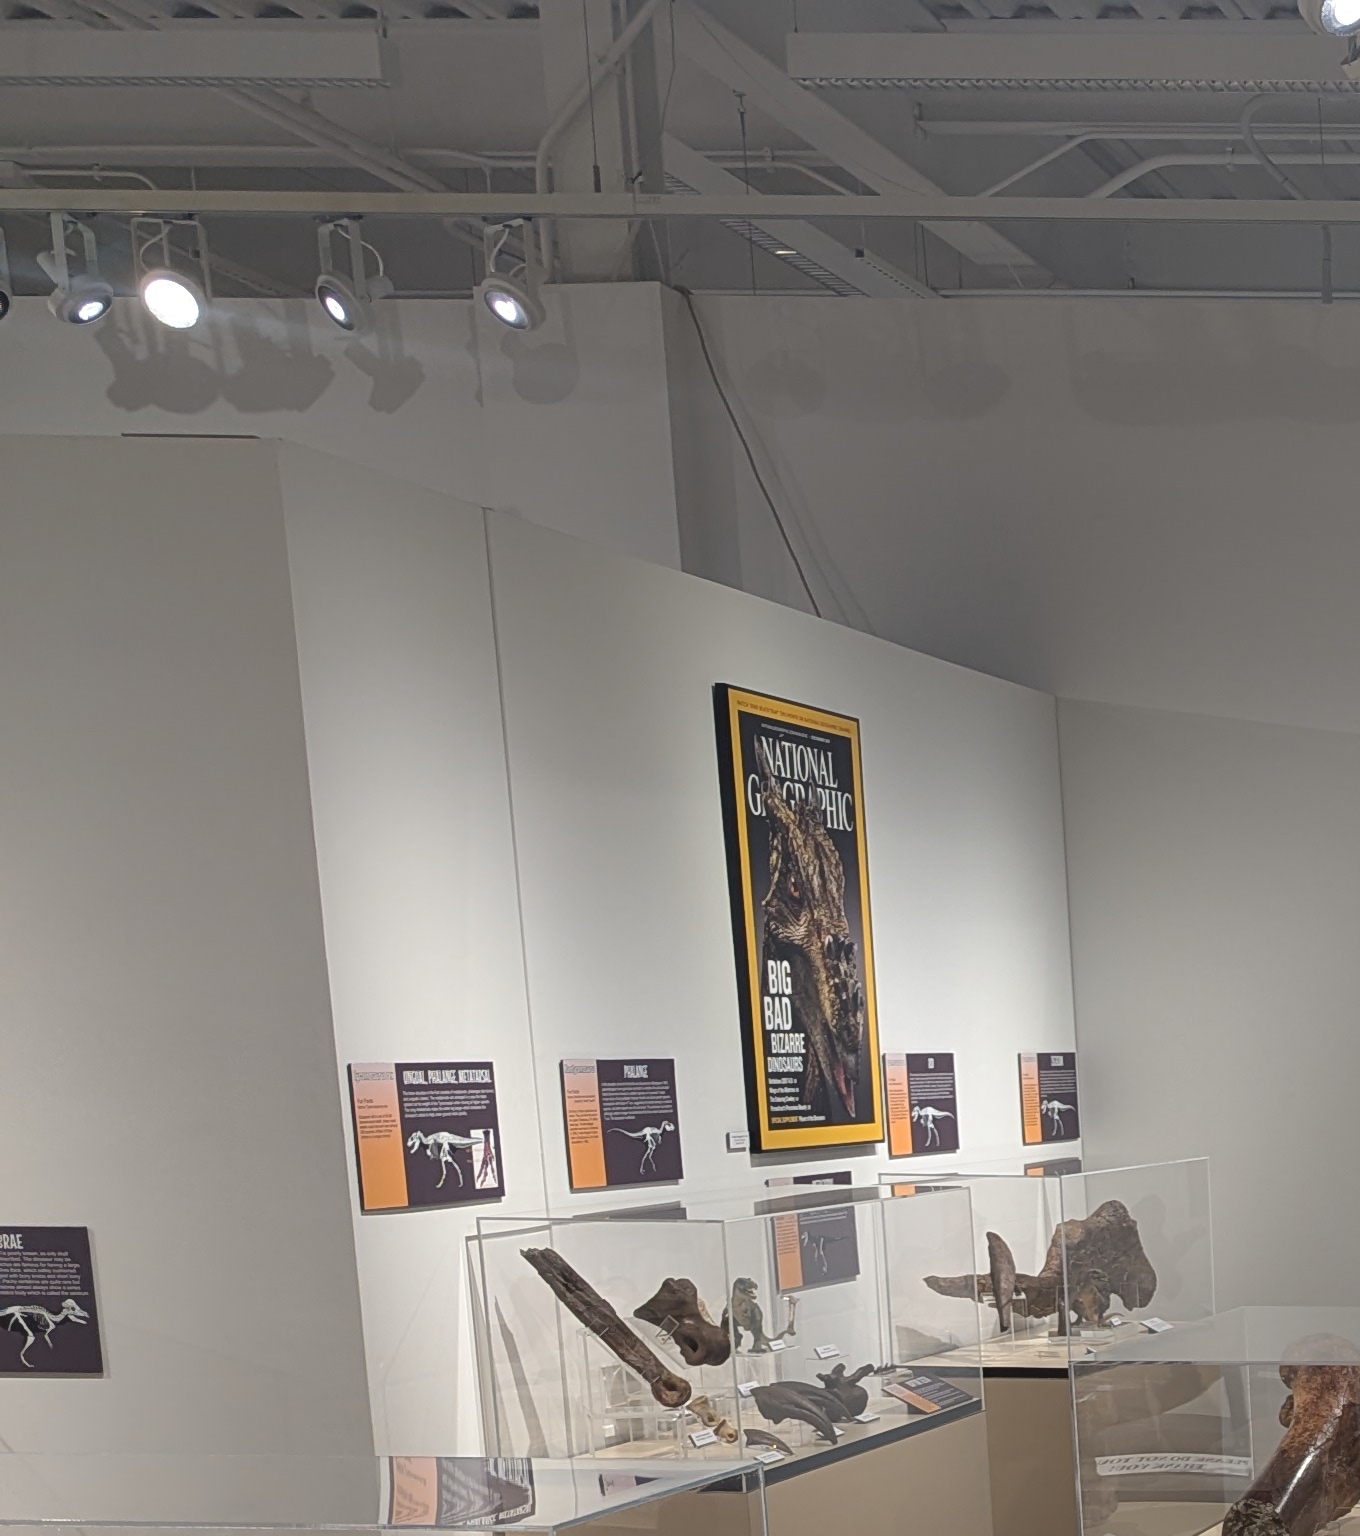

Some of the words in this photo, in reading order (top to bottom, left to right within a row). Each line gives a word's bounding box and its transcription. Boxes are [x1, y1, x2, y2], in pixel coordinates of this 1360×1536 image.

[760, 736, 838, 788] NATIONAL
[767, 959, 792, 995] BIG
[763, 996, 793, 1030] BAD
[770, 1033, 806, 1054] BIZARRE
[767, 1056, 804, 1073] DINOSAURS
